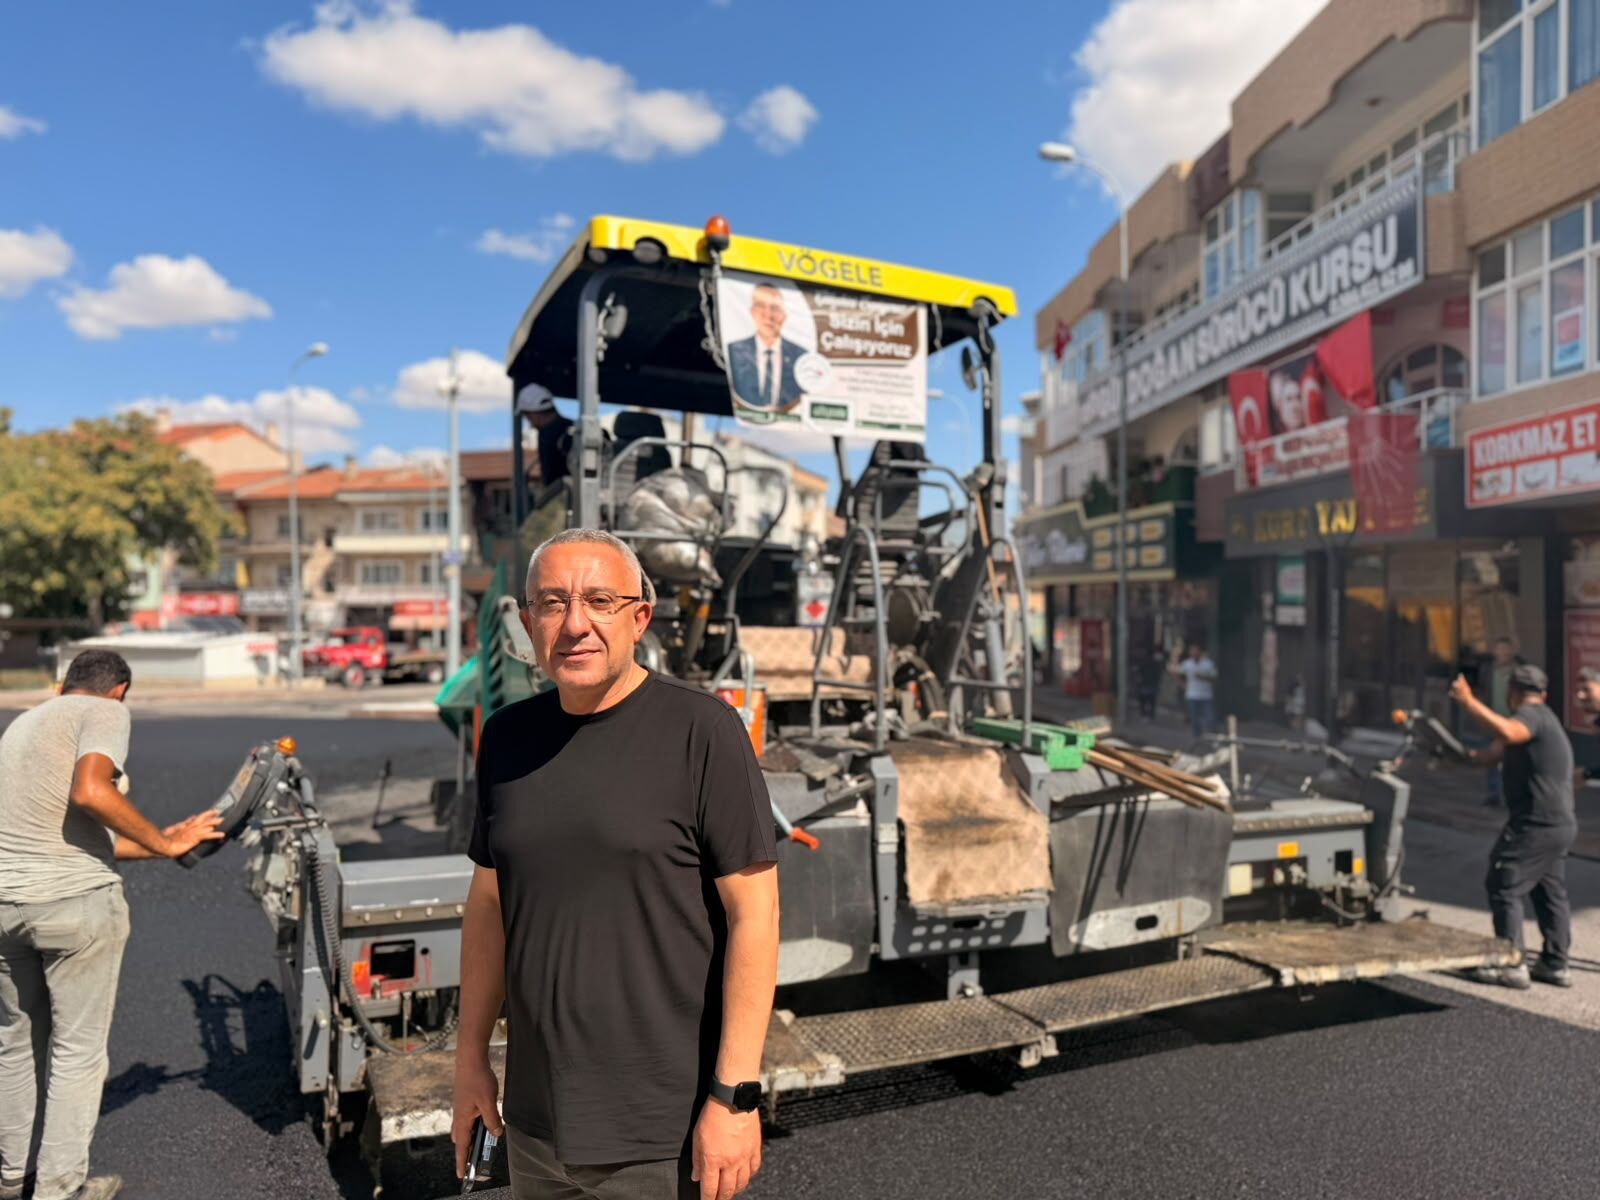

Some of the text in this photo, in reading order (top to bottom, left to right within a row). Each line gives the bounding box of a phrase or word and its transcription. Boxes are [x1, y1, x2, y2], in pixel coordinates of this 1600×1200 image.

[776, 247, 884, 288] VÖGELE
[1289, 213, 1398, 317] KURSU
[1473, 412, 1598, 469] KORKMAZ ET
